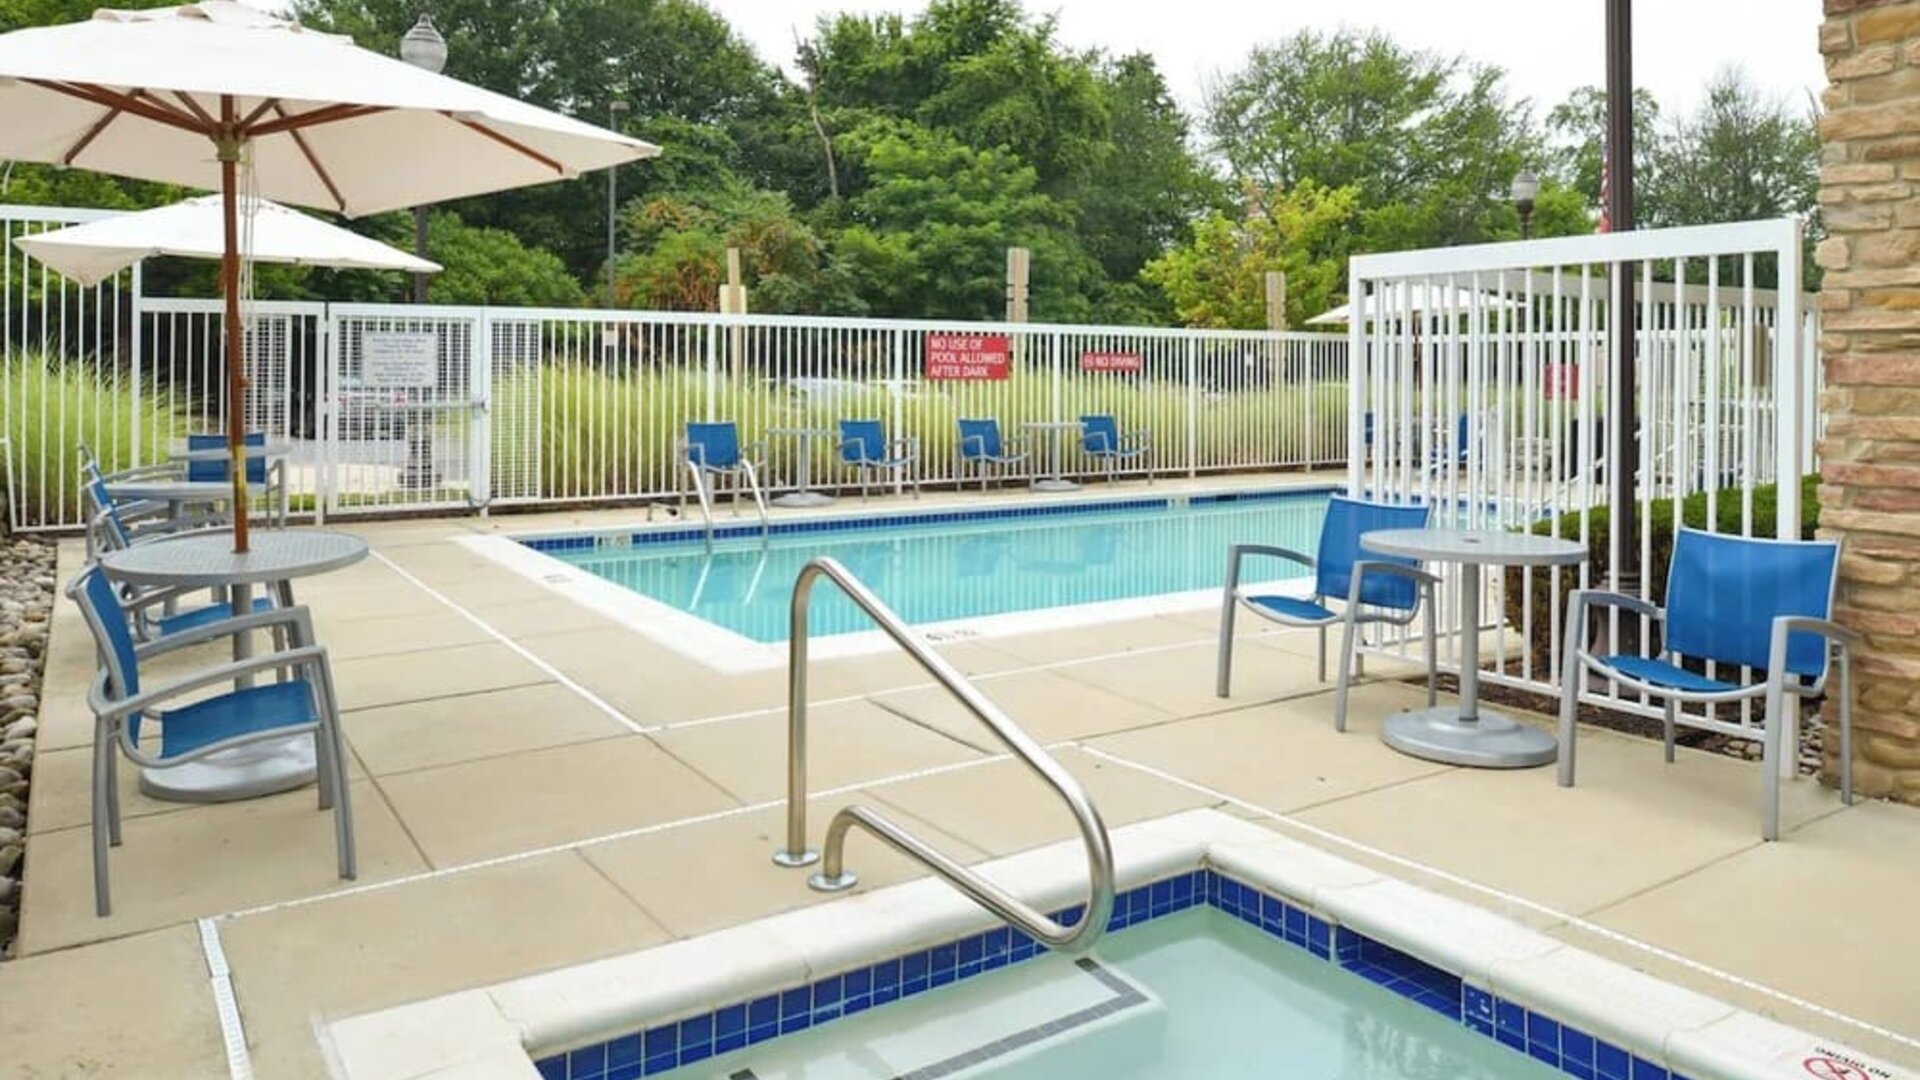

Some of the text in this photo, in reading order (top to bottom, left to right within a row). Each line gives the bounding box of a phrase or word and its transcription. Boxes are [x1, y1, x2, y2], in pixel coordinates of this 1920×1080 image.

[930, 338, 982, 350] NO USE OF
[930, 351, 1005, 363] POOL ALLOWED
[1095, 356, 1139, 368] NO DIVING
[930, 366, 988, 377] AFTER DARK
